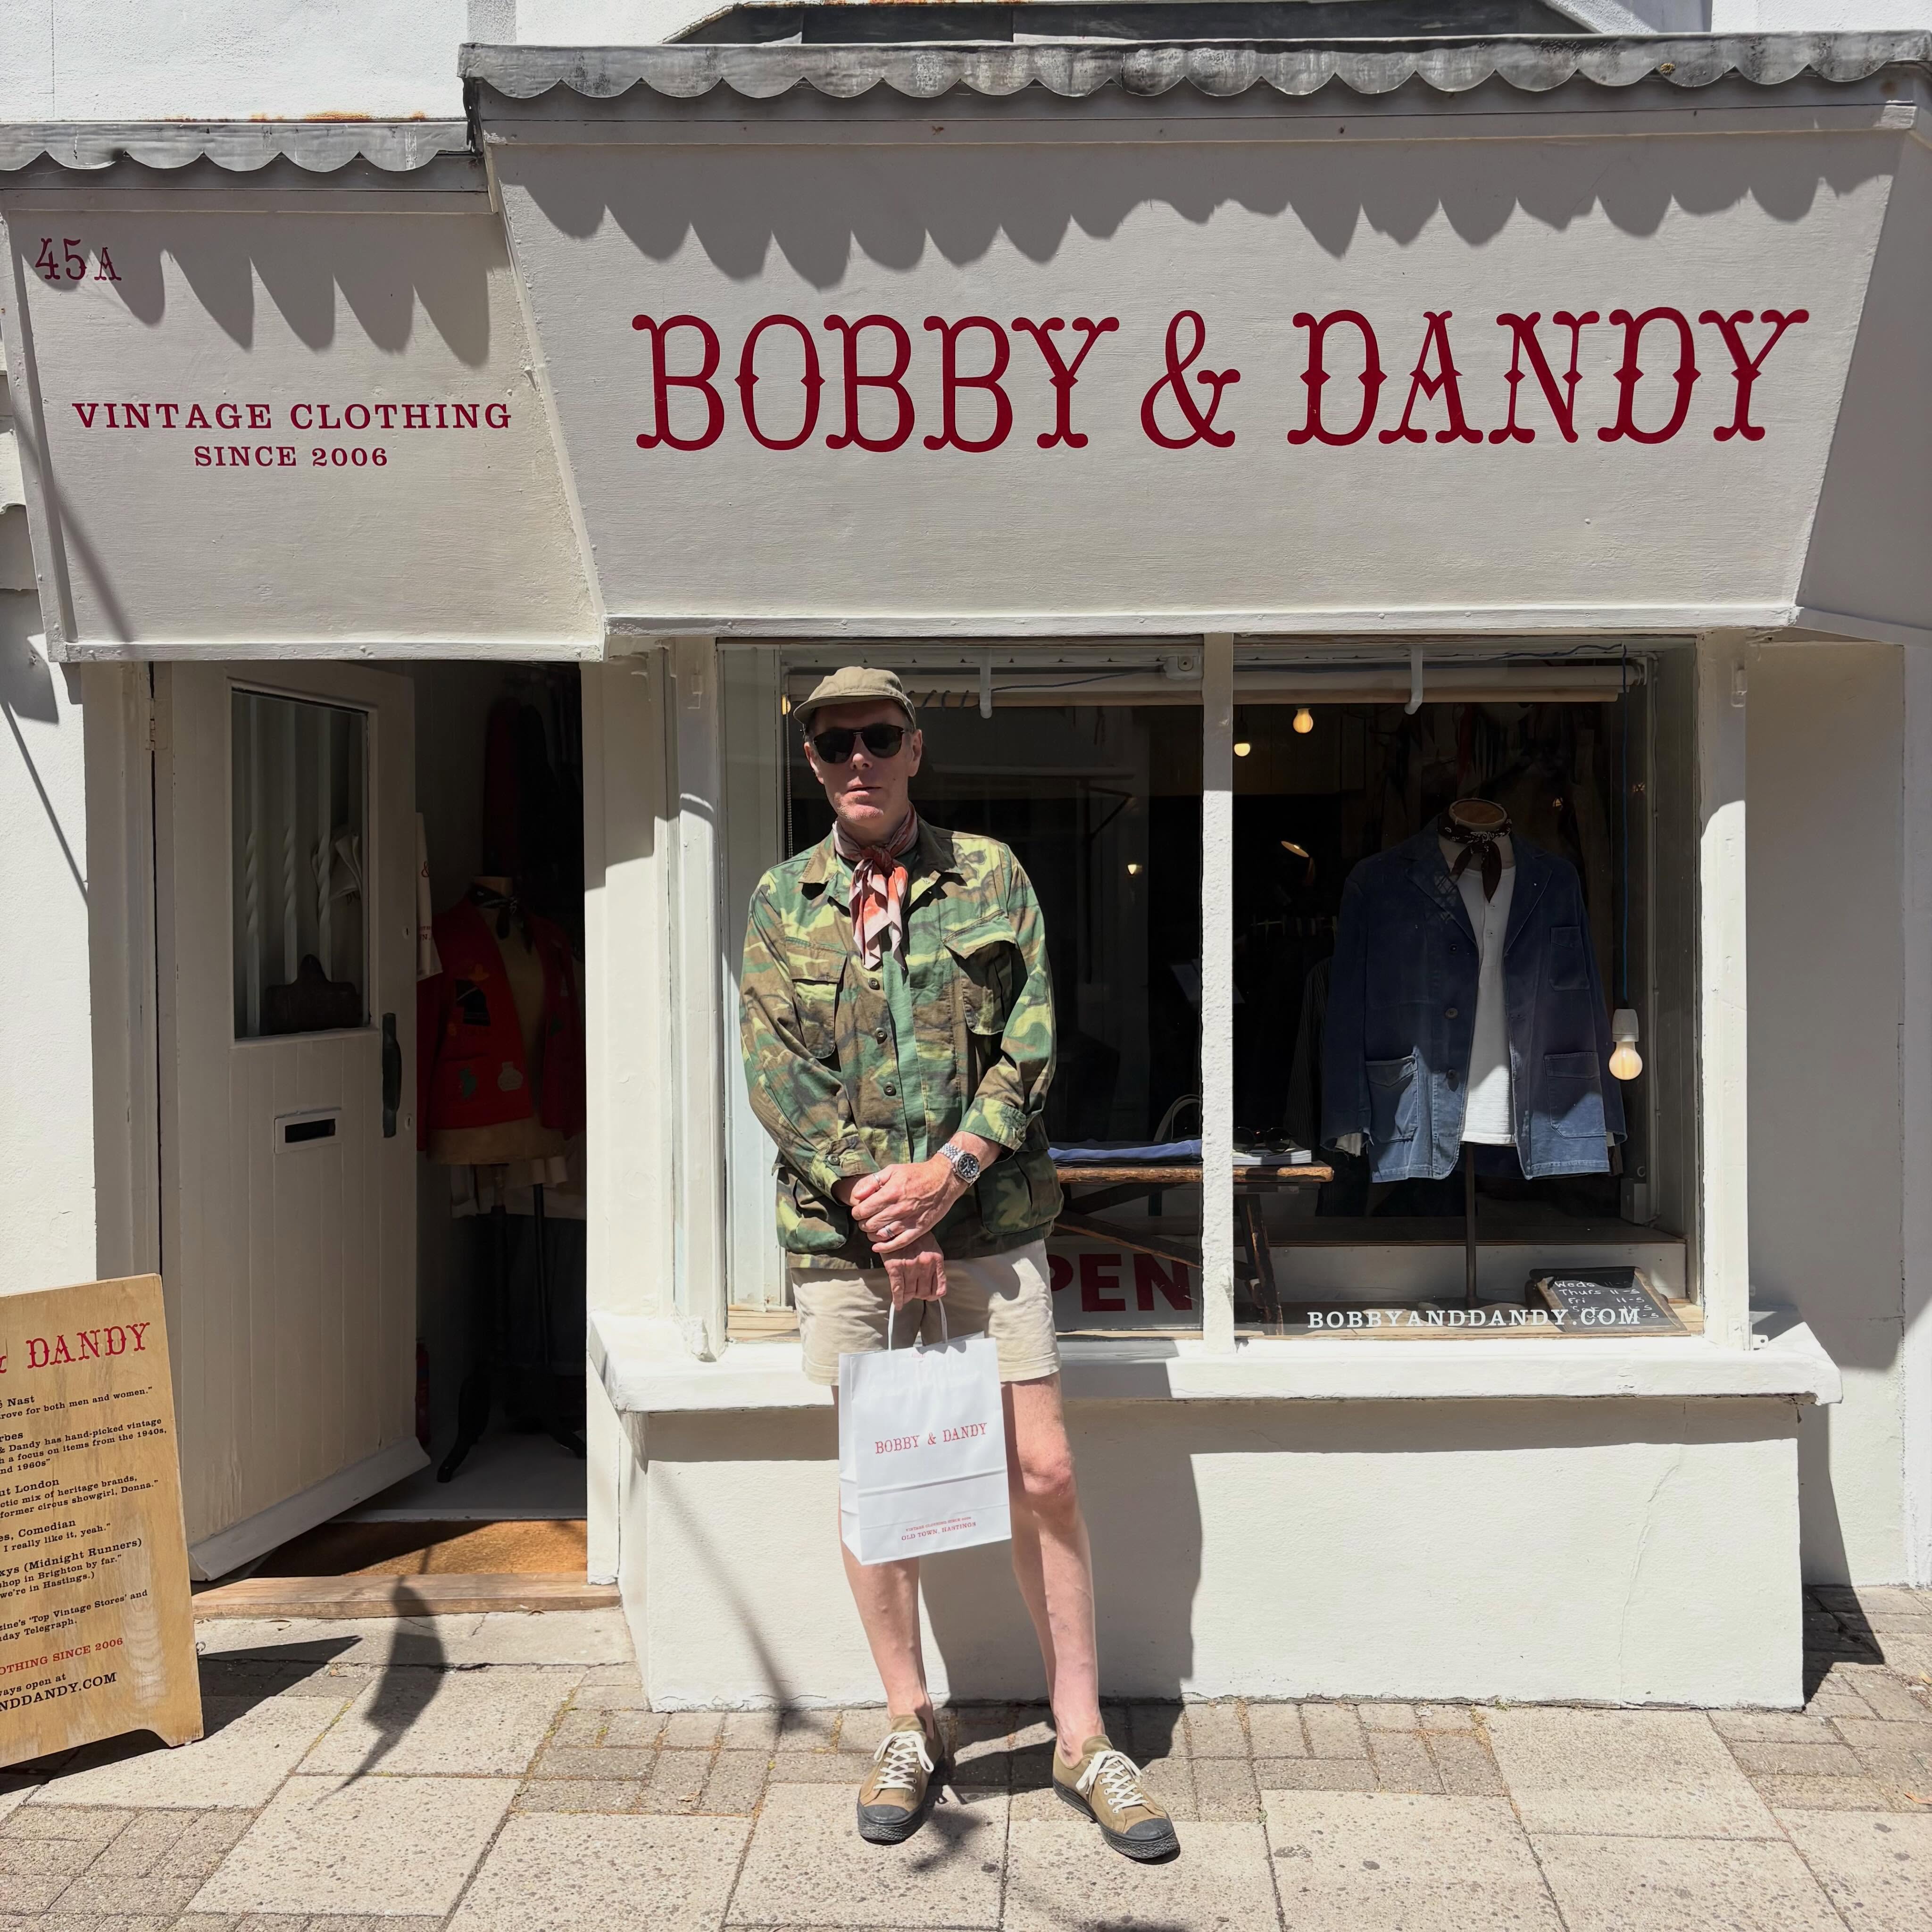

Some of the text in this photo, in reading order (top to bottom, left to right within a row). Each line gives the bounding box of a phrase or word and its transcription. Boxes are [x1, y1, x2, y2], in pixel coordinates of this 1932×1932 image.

[34, 238, 122, 282] 45A
[632, 307, 1810, 454] BOBBY & DANDY
[72, 402, 513, 430] VINTAGE CLOTHING
[194, 446, 388, 467] SINCE 2006
[1307, 1307, 1641, 1329] BOBBYANDDANDY.COM
[26, 1322, 150, 1369] DANDY
[8, 1395, 35, 1407] Nast
[26, 1407, 41, 1415] for
[44, 1401, 65, 1412] both
[69, 1399, 89, 1407] men
[92, 1394, 110, 1403] and
[9, 1441, 41, 1452] Dandy
[44, 1437, 61, 1445] has
[65, 1424, 124, 1441] hand-picked
[127, 1418, 162, 1430] vintage
[18, 1451, 44, 1461] focus
[63, 1441, 89, 1452] items
[92, 1436, 116, 1447] from
[118, 1433, 133, 1441] the
[137, 1427, 167, 1438] 1940s,
[874, 1422, 988, 1454] BOBBY & DANDY
[15, 1479, 60, 1494] London
[22, 1494, 42, 1504] mix
[45, 1491, 55, 1499] of
[58, 1482, 99, 1497] heritage
[102, 1475, 138, 1488] brands,
[0, 1506, 34, 1519] former
[38, 1499, 69, 1511] circus
[72, 1488, 118, 1504] showgirl,
[18, 1520, 76, 1538] Comedian
[941, 1521, 976, 1533] HASTINGS
[12, 1539, 41, 1551] really
[44, 1534, 63, 1544] like
[24, 1550, 84, 1573] (Midnight
[88, 1538, 142, 1557] Runners)
[24, 1575, 34, 1583] in
[38, 1565, 83, 1580] Brighton
[86, 1560, 98, 1570] by
[43, 1571, 95, 1589] Hastings.)
[53, 1603, 92, 1618] Vintage
[130, 1590, 148, 1601] and
[24, 1617, 77, 1636] Telegraph.
[52, 1645, 91, 1662] SINCE
[95, 1637, 124, 1652] 2006
[25, 1678, 52, 1690] open
[55, 1673, 67, 1682] at
